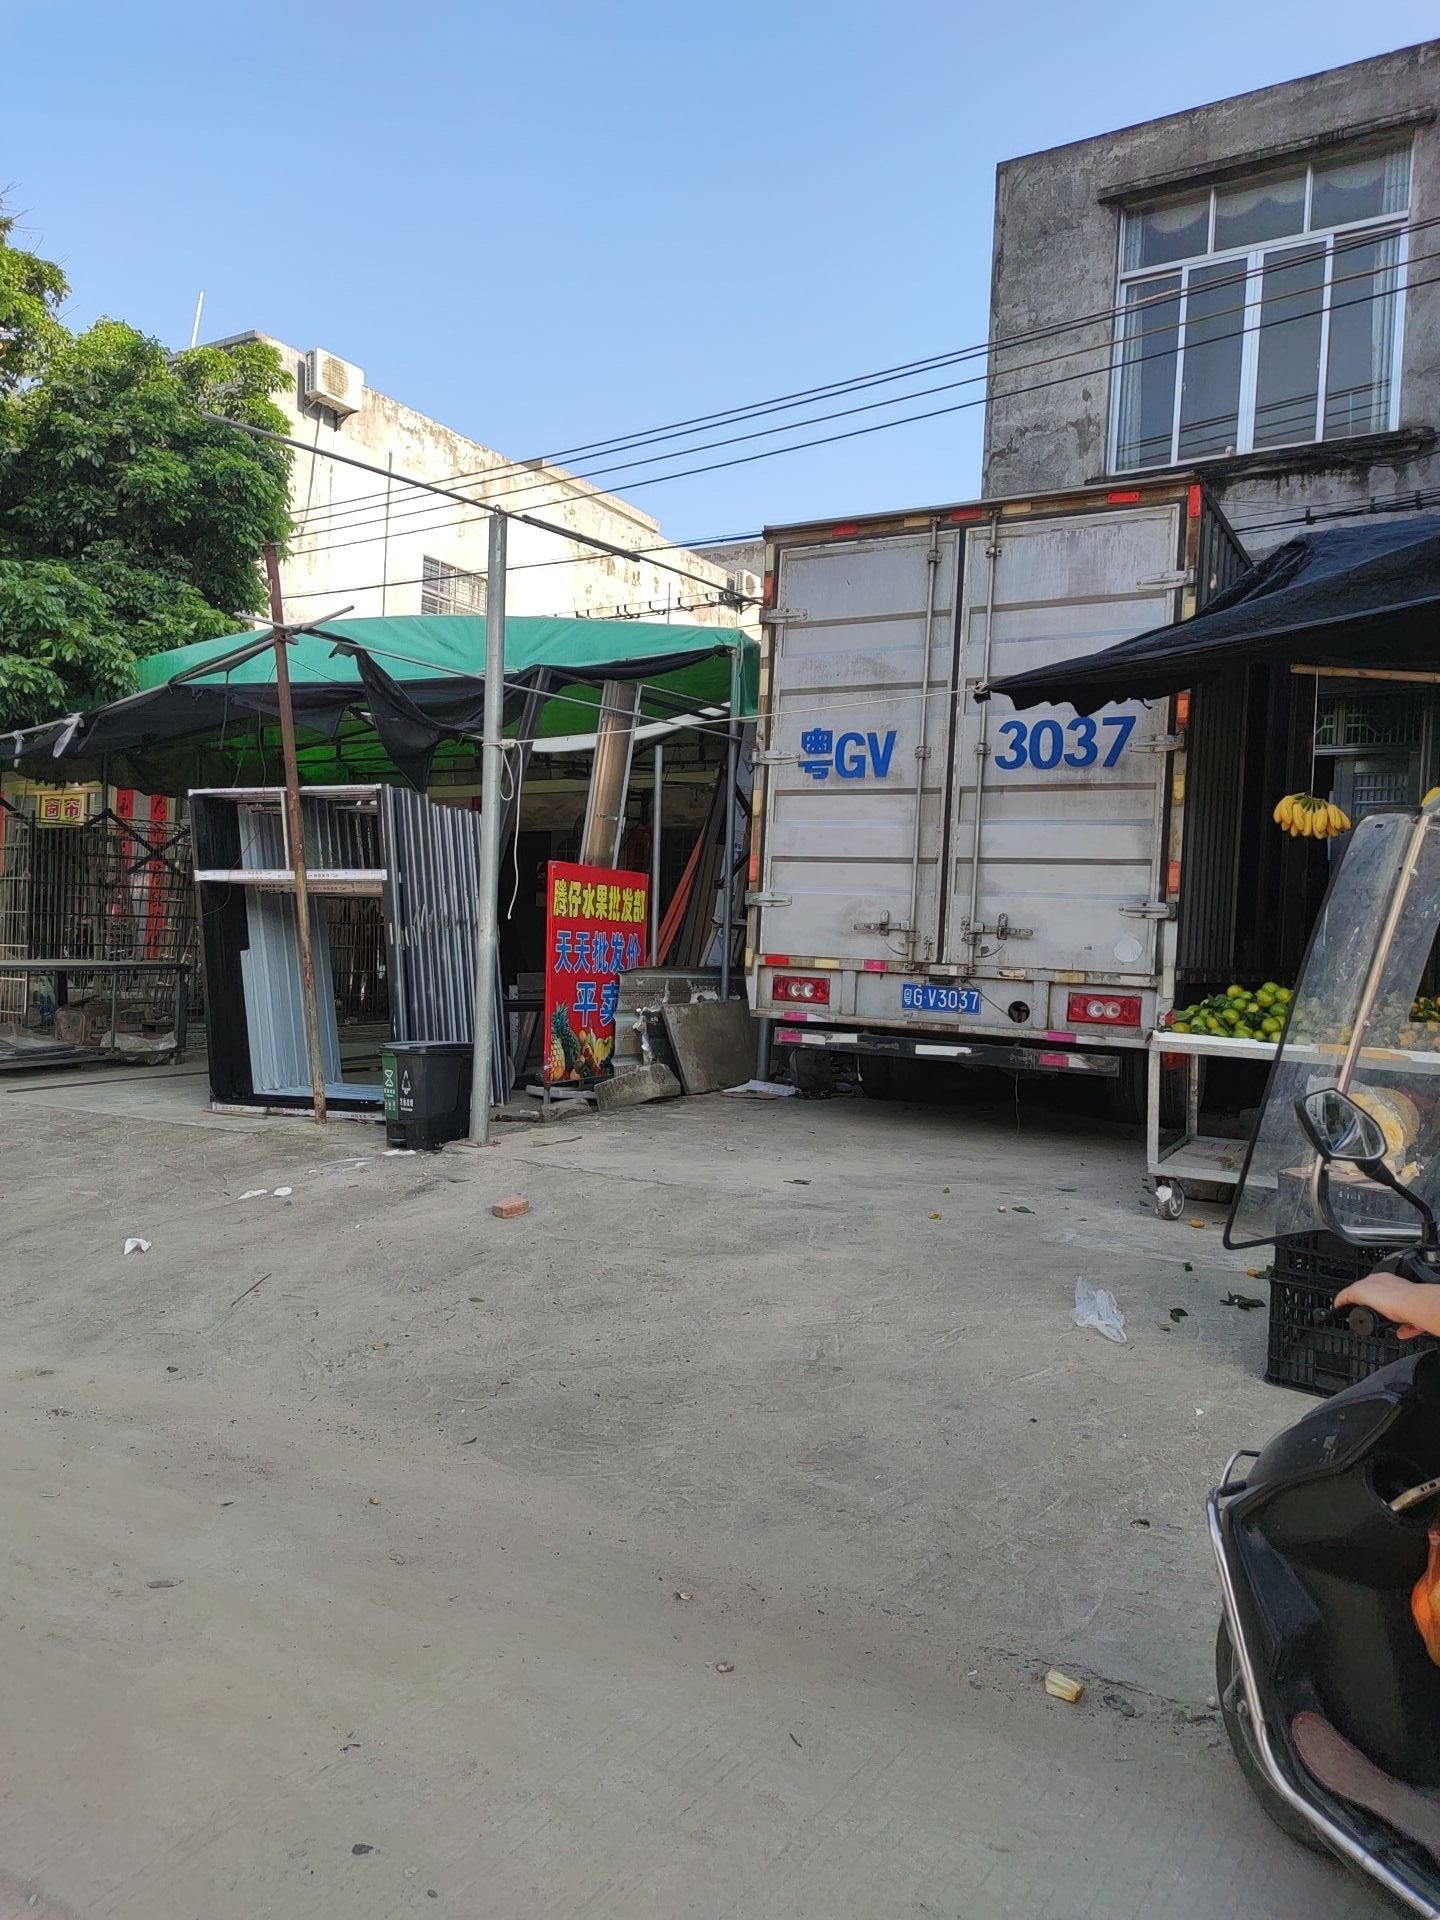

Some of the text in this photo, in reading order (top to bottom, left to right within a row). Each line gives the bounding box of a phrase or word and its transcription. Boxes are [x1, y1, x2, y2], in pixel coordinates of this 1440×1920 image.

[798, 716, 1136, 779] 粤GV 3037
[554, 930, 641, 974] 天天批发价
